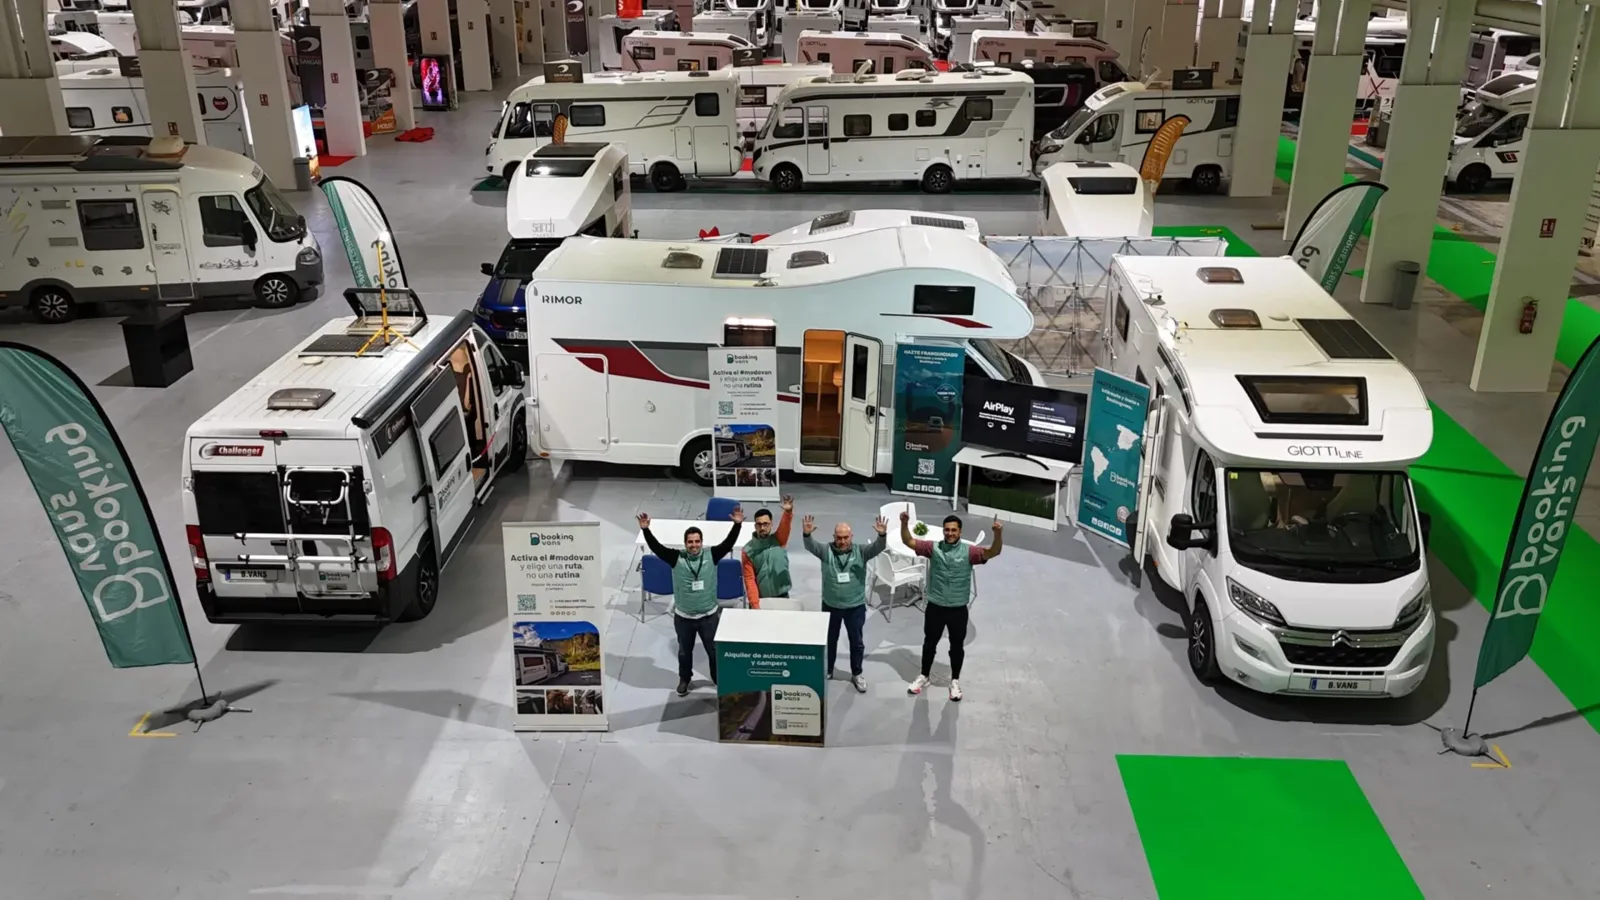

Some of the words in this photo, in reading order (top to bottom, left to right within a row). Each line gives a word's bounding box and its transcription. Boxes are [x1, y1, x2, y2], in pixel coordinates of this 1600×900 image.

[542, 295, 582, 304] RIMOR
[983, 400, 1014, 415] AirPlay
[219, 446, 260, 456] Challenger
[1510, 416, 1585, 570] booking
[1539, 476, 1576, 564] vans
[541, 532, 574, 542] booking
[526, 563, 546, 571] elige
[1328, 680, 1358, 690] B.VANS
[784, 690, 811, 698] booking
